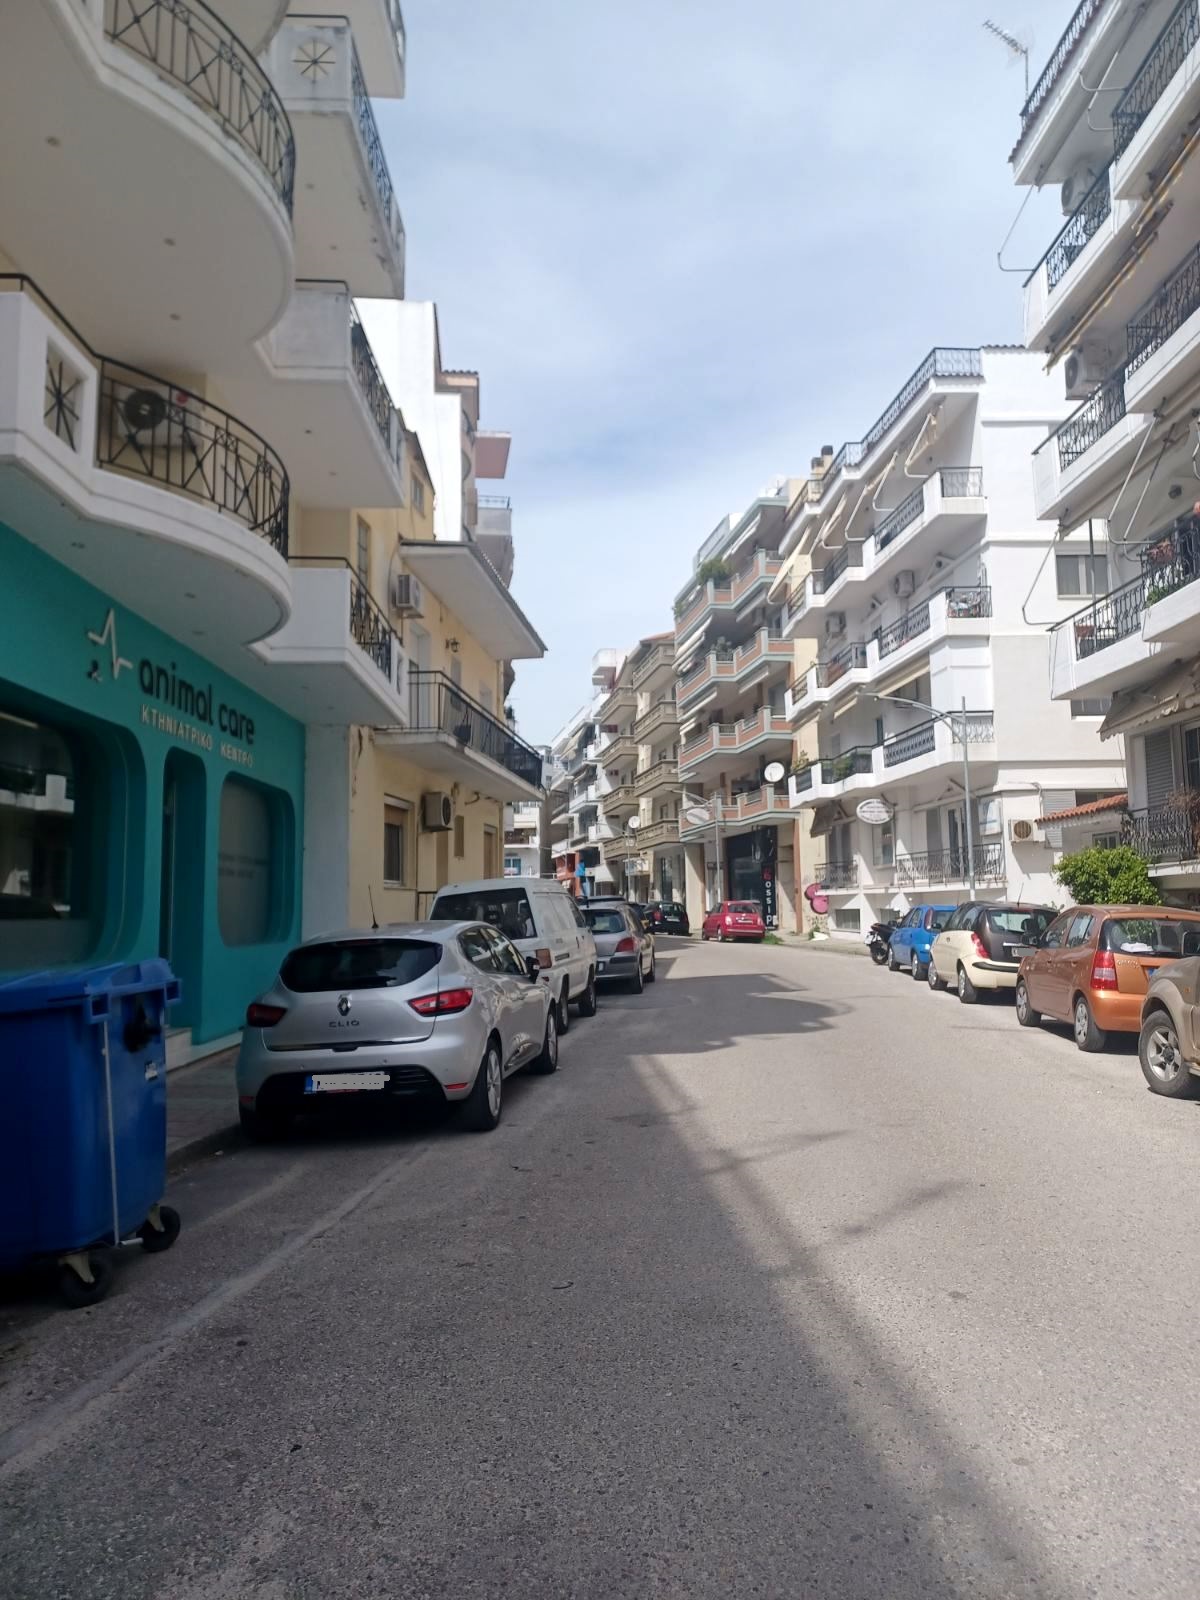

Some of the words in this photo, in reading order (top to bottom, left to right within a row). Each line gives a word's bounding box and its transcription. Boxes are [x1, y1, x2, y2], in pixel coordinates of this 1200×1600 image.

[140, 658, 214, 726] animal
[218, 702, 256, 745] care
[142, 704, 214, 751] ΚΤΗΝΙΑΤΡΙΚΟ
[219, 743, 254, 768] ΚΕΝΤΡΟ
[329, 1020, 360, 1028] CLIO
